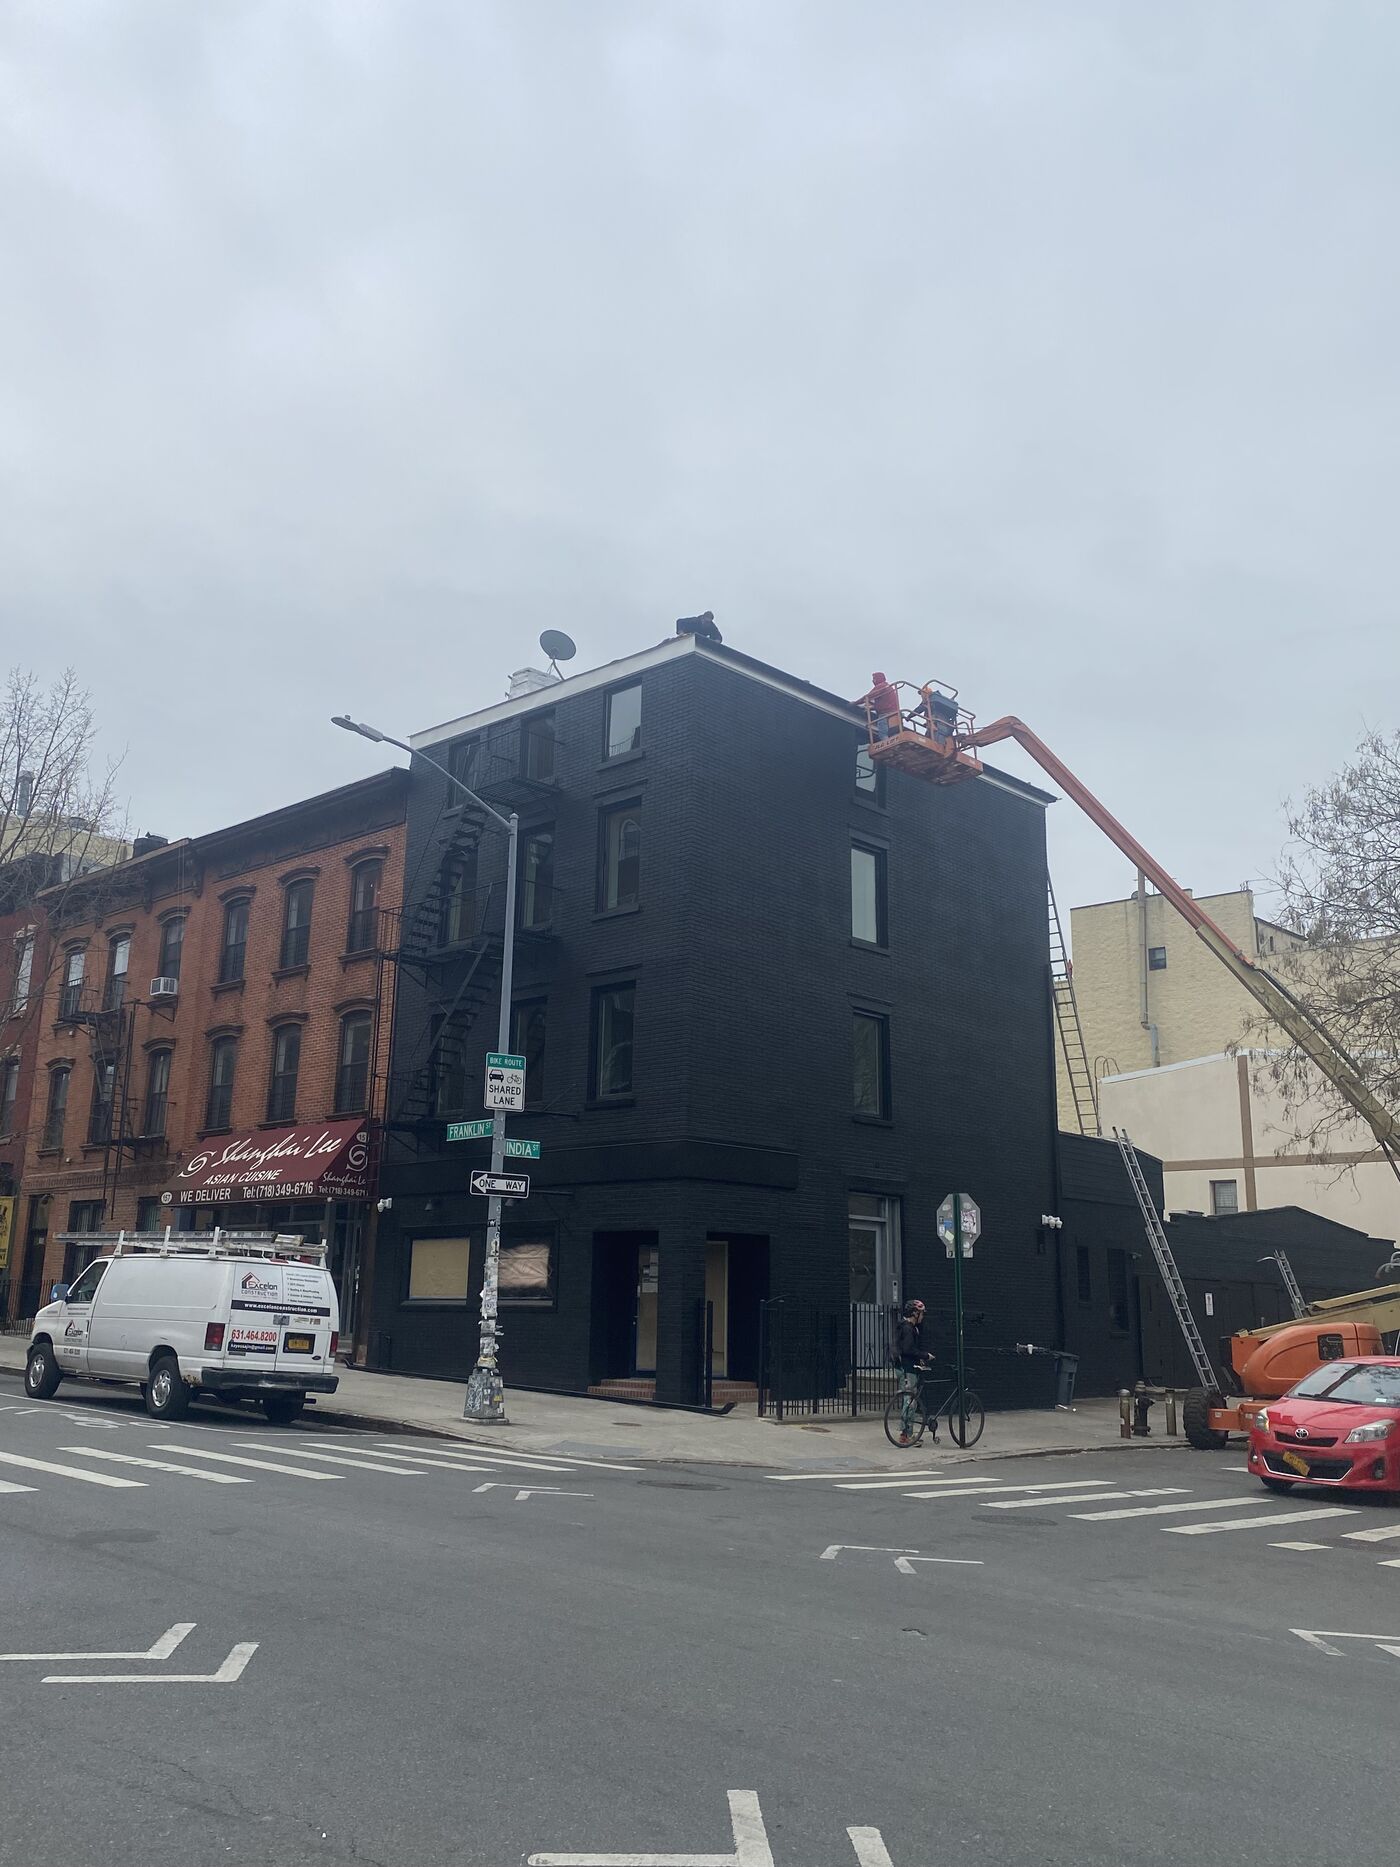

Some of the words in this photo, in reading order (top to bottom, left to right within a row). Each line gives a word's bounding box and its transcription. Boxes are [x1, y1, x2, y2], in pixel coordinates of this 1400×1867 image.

[489, 1056, 502, 1065] BIKE
[504, 1057, 522, 1067] ROUTE
[489, 1084, 521, 1096] SHARED
[493, 1096, 515, 1106] LANE
[449, 1123, 485, 1139] FRANKLIN
[211, 1133, 310, 1170] Shanghai
[303, 1130, 342, 1159] Lee
[506, 1141, 532, 1156] INDIA
[203, 1173, 237, 1185] ASIAN
[238, 1169, 283, 1183] CUISINE
[357, 1175, 367, 1185] Le
[478, 1178, 496, 1189] ONE
[505, 1180, 524, 1191] WAY
[180, 1190, 194, 1203] WE
[195, 1187, 231, 1202] DELIVER
[247, 1281, 278, 1291] Excelon
[231, 1329, 277, 1342] 631.464.8200
